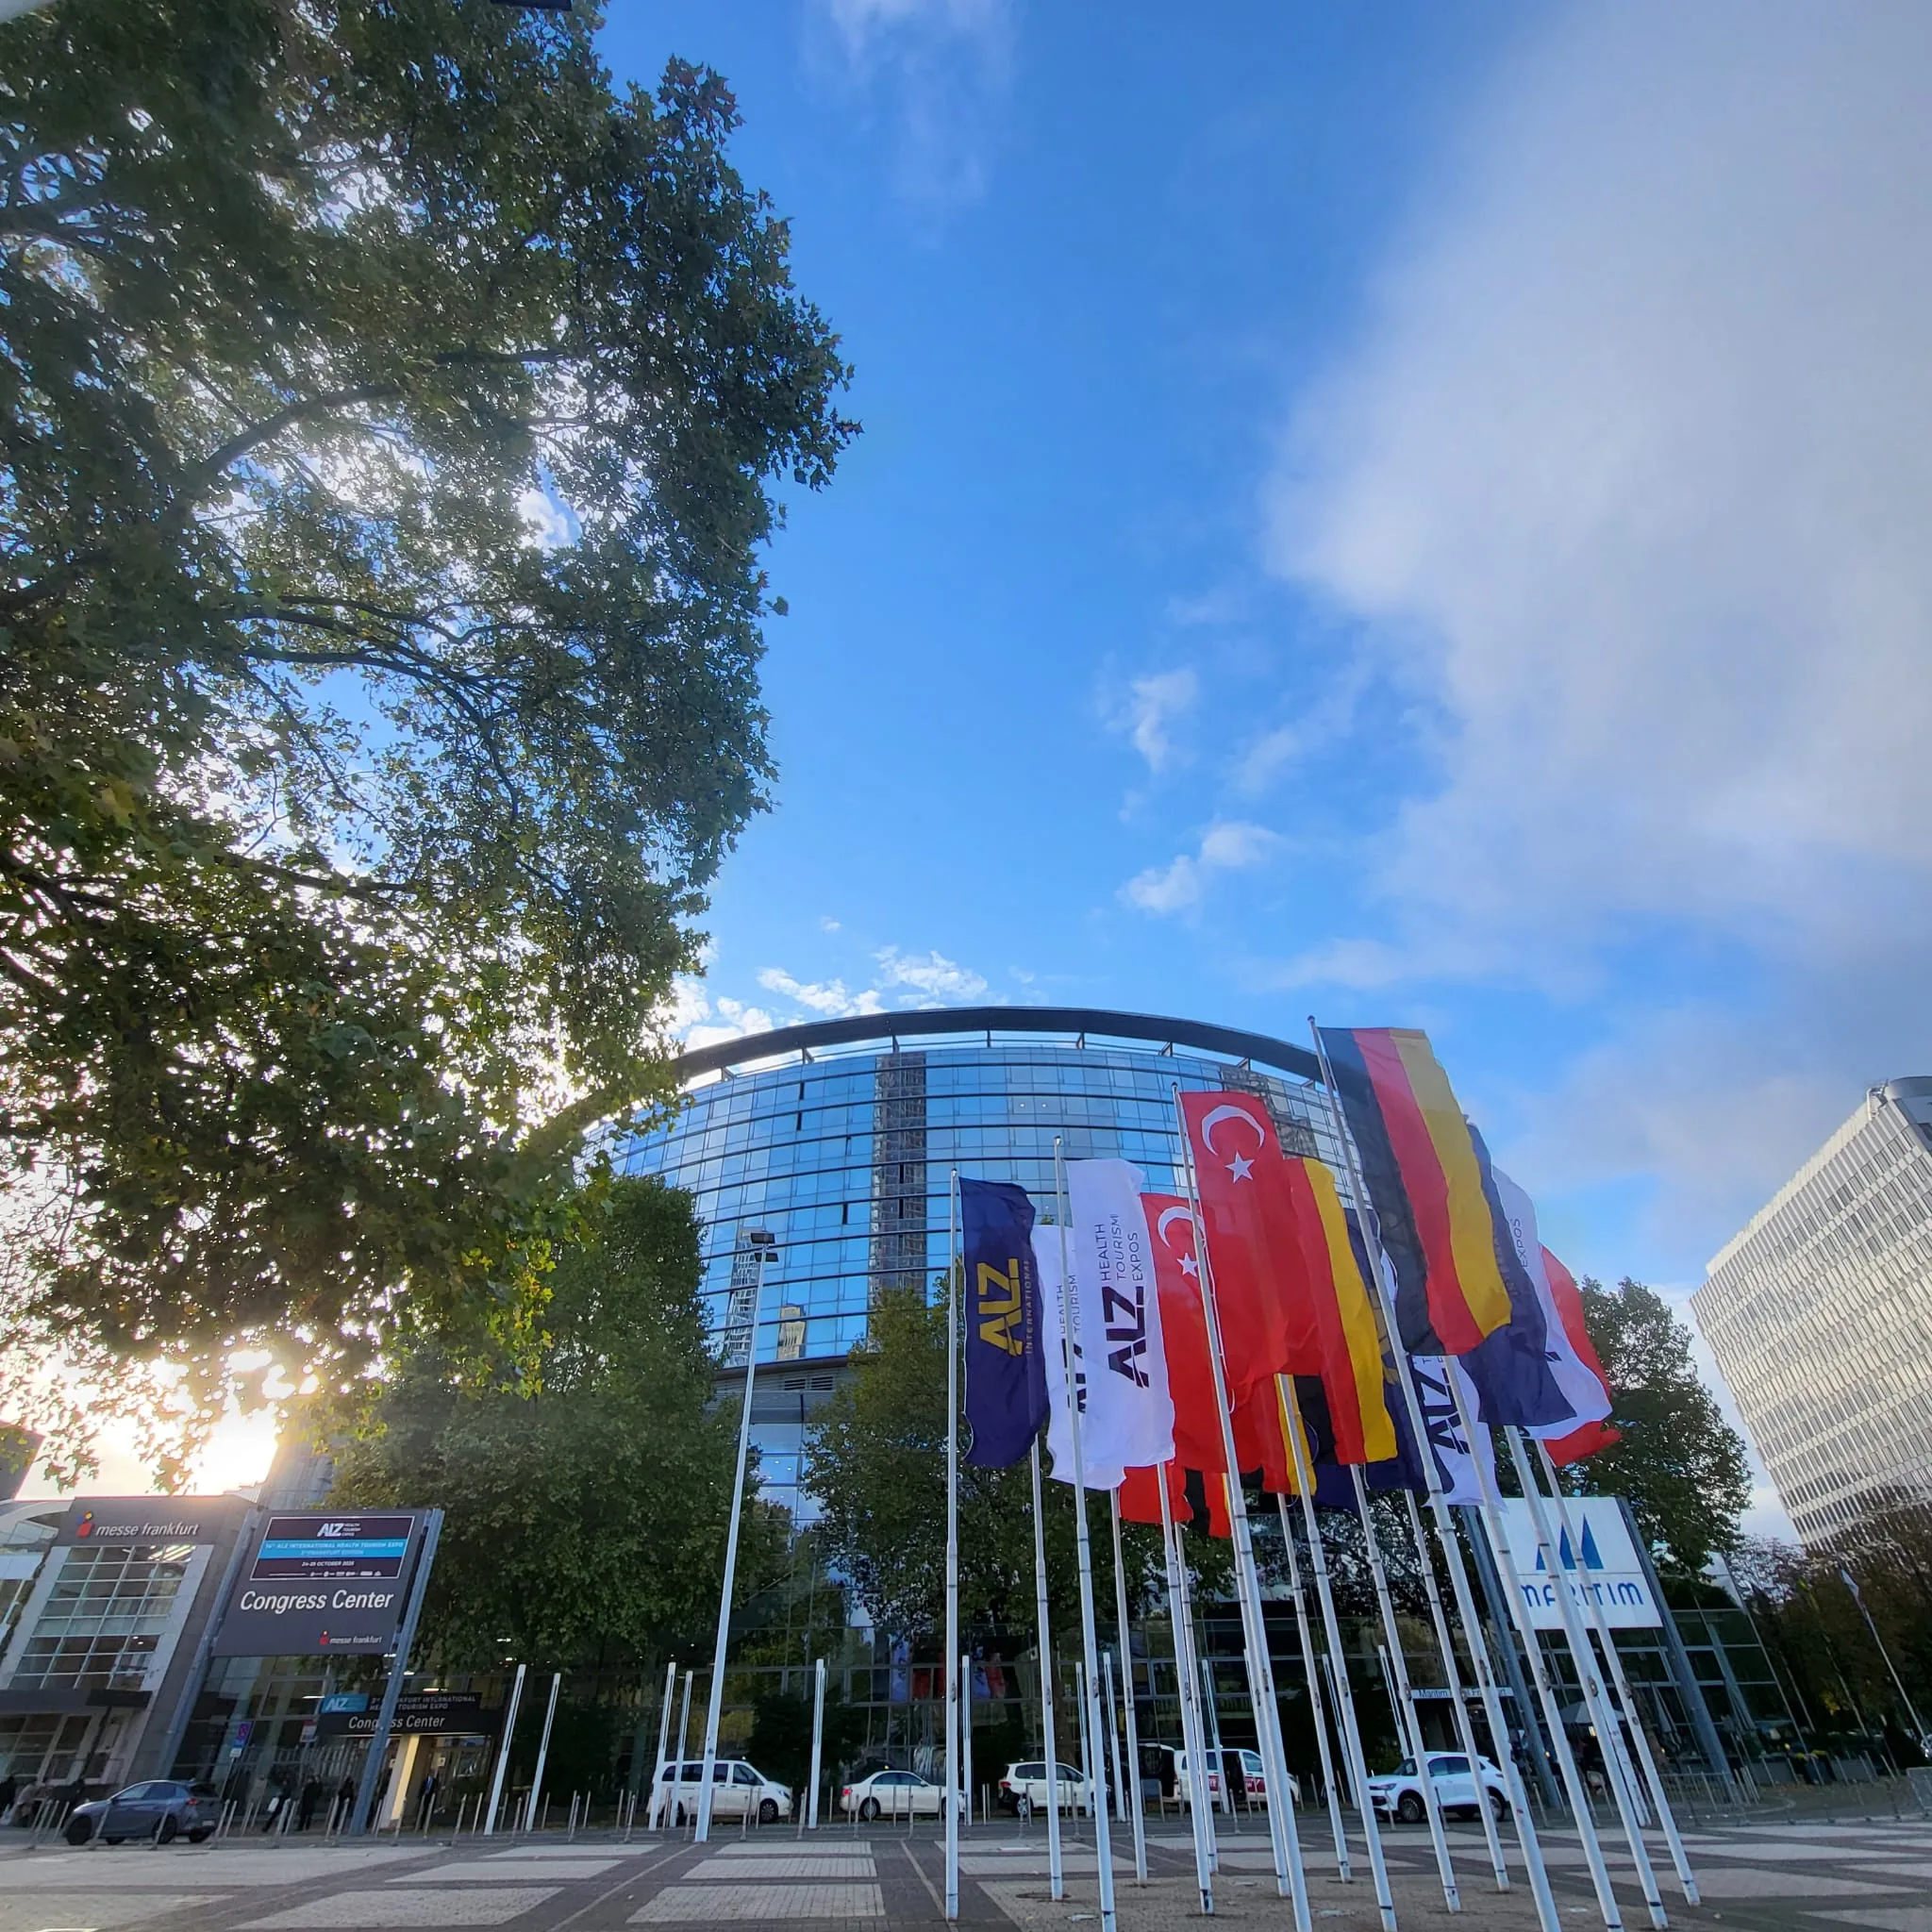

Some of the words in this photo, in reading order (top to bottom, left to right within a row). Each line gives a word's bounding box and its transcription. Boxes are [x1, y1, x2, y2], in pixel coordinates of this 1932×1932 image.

[1094, 1224, 1111, 1282] HEALTH
[1108, 1213, 1126, 1281] TOURISM
[1127, 1232, 1143, 1281] EXPOS
[976, 1257, 1024, 1357] ALZ
[1101, 1286, 1150, 1390] ALZ
[95, 1525, 139, 1536] messe
[142, 1521, 199, 1536] frankfurt
[241, 1591, 327, 1614] Congress
[332, 1590, 394, 1608] Center
[348, 1716, 404, 1730] Congss
[406, 1715, 446, 1727] Center
